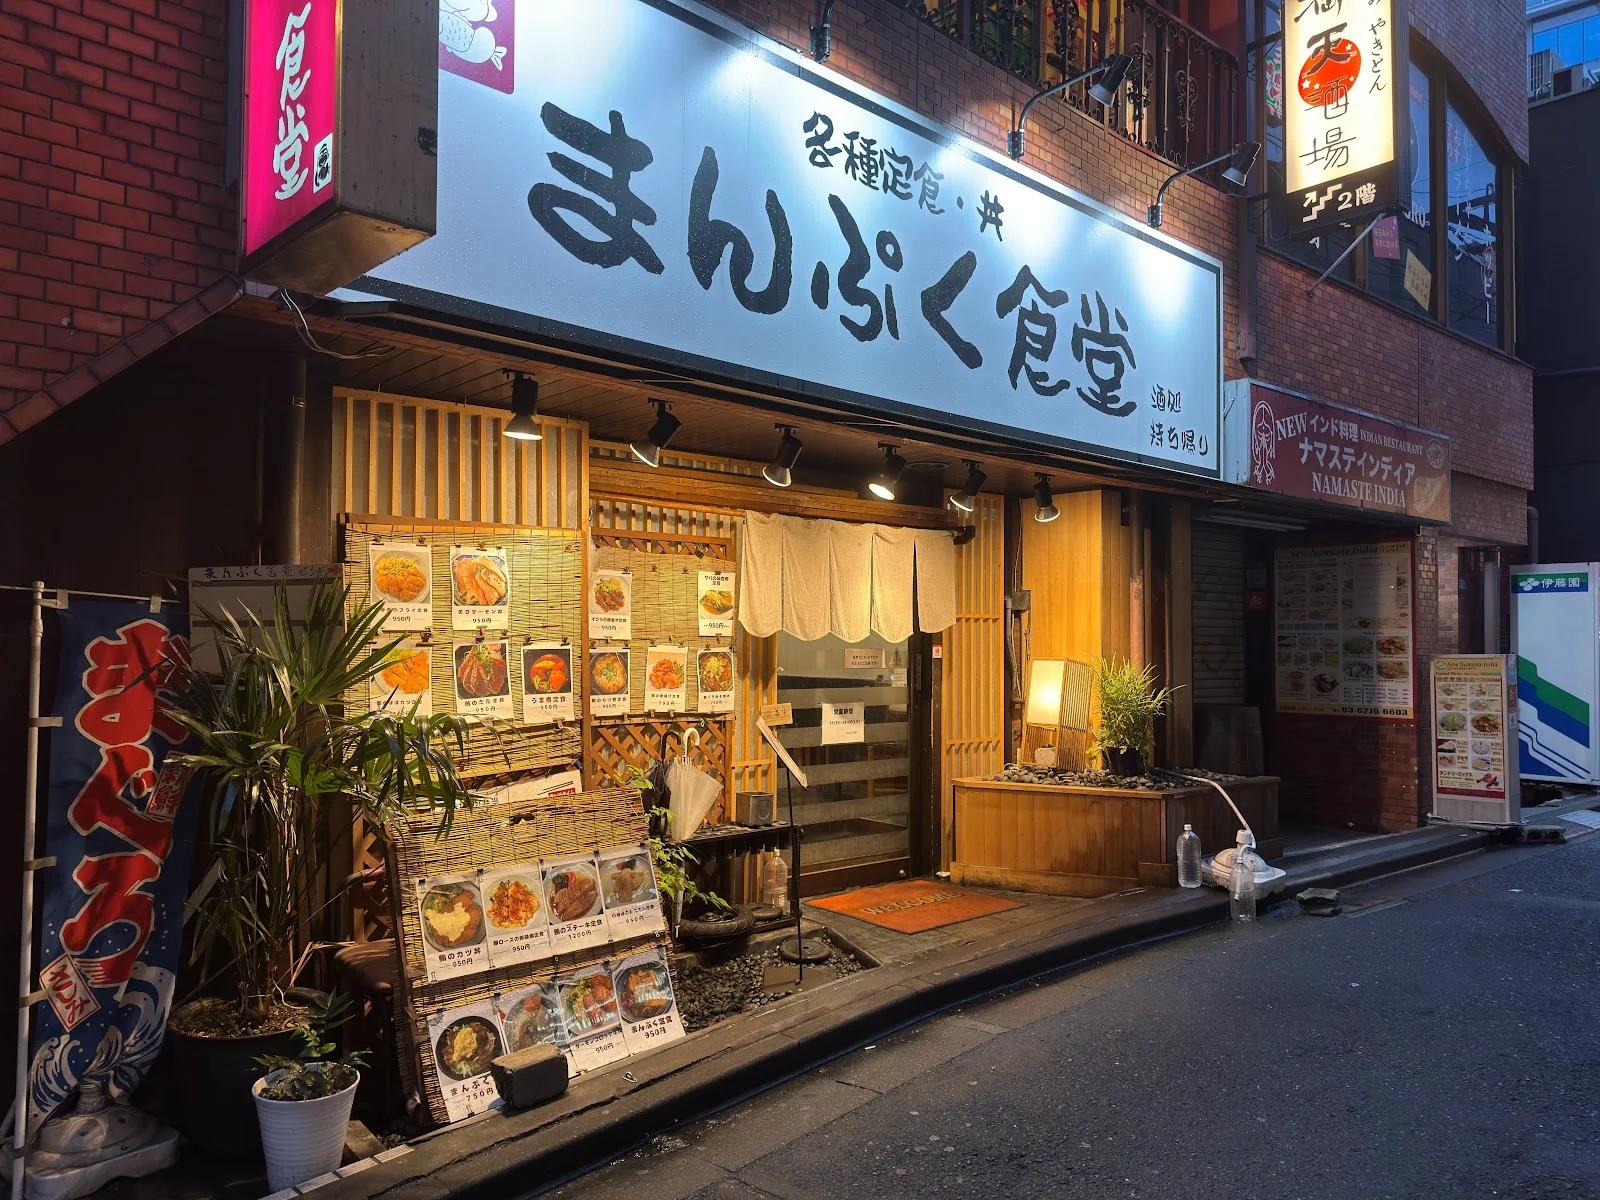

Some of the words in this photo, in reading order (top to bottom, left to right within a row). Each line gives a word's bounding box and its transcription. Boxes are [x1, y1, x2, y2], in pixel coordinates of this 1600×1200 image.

[1369, 18, 1387, 94] やきとん
[274, 2, 311, 200] 食堂
[1338, 183, 1376, 212] 2階
[527, 101, 1138, 417] まんぷく食堂
[1151, 384, 1181, 413] 酒処
[1151, 419, 1208, 456] 持ち帰り
[1276, 412, 1308, 441] NEW
[1310, 414, 1359, 443] インド料理
[1360, 428, 1383, 446] INDIAN
[1383, 434, 1423, 456] RESTAURANT
[1299, 437, 1416, 486] ナマステインディア
[1312, 472, 1372, 500] NAMASTE
[1374, 484, 1406, 508] INDIA
[1541, 578, 1580, 588] 伊藤園
[512, 943, 531, 953] 950円
[452, 958, 474, 968] 950円
[644, 1026, 667, 1040] 950円
[595, 1043, 614, 1053] 950円
[465, 1086, 494, 1102] 750円
